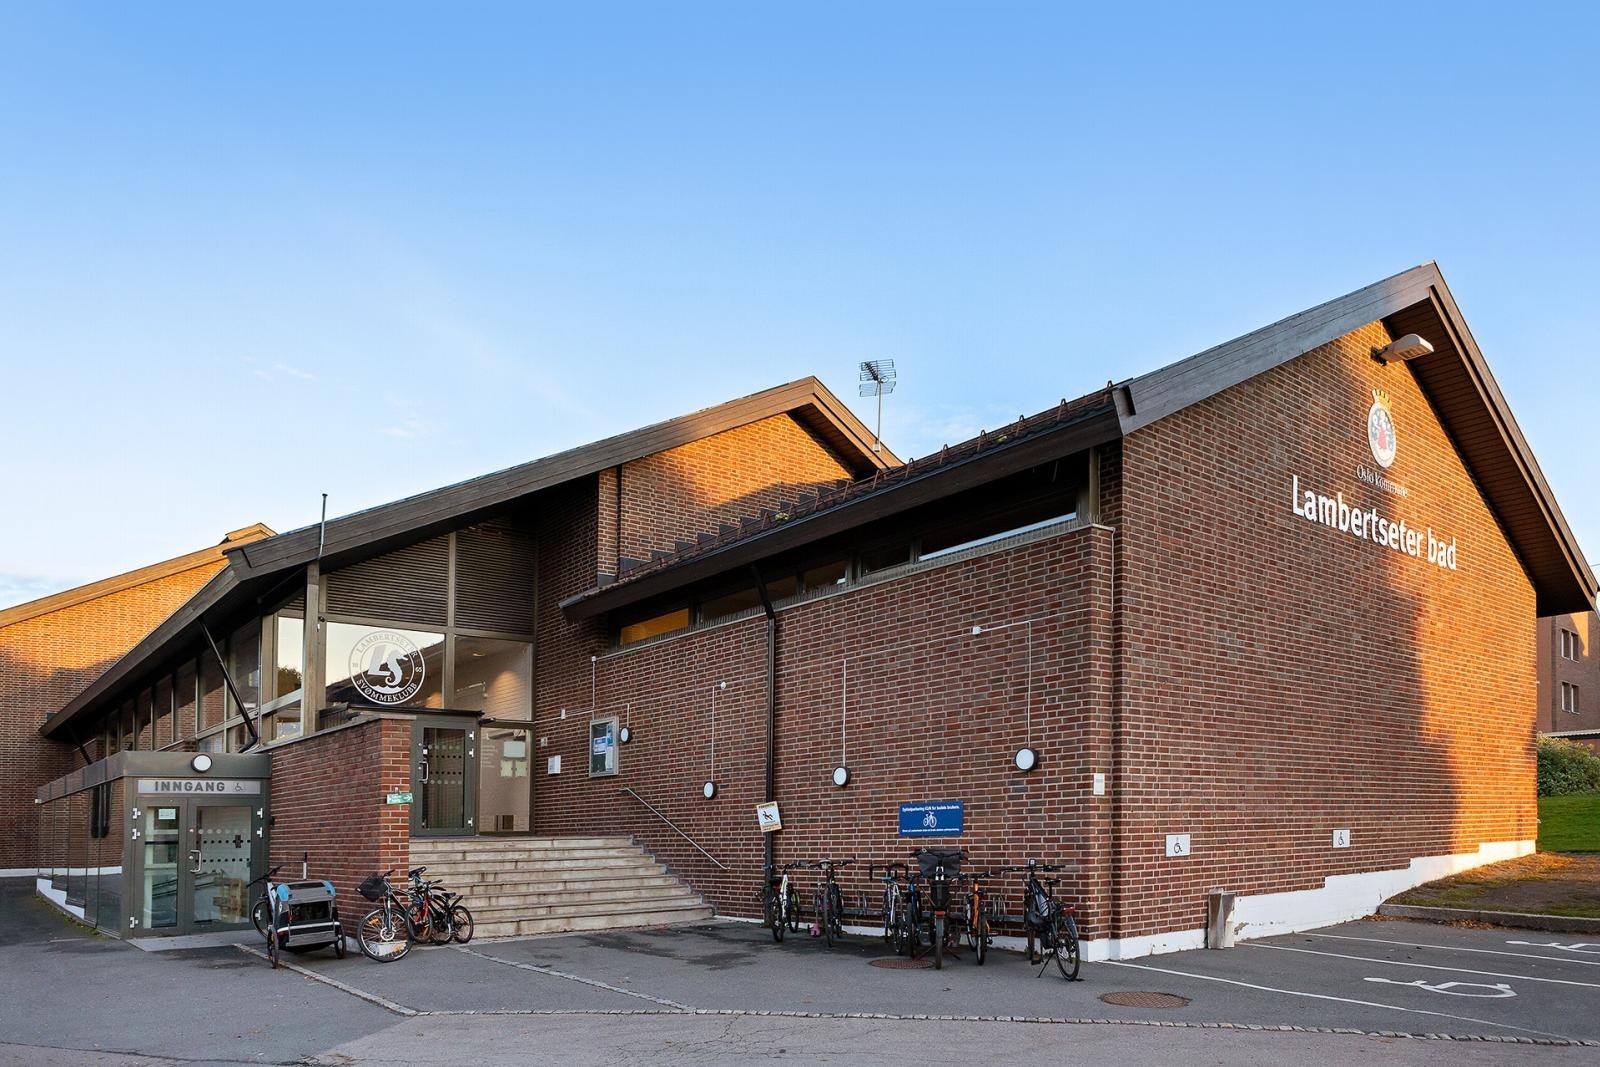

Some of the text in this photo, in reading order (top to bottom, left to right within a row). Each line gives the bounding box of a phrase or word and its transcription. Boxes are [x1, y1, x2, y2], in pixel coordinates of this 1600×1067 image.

[1356, 464, 1374, 484] Oslo
[1292, 474, 1457, 571] Lambertseter bad
[356, 679, 418, 702] SVØMMEKLUBB
[154, 781, 225, 792] INNGANG
